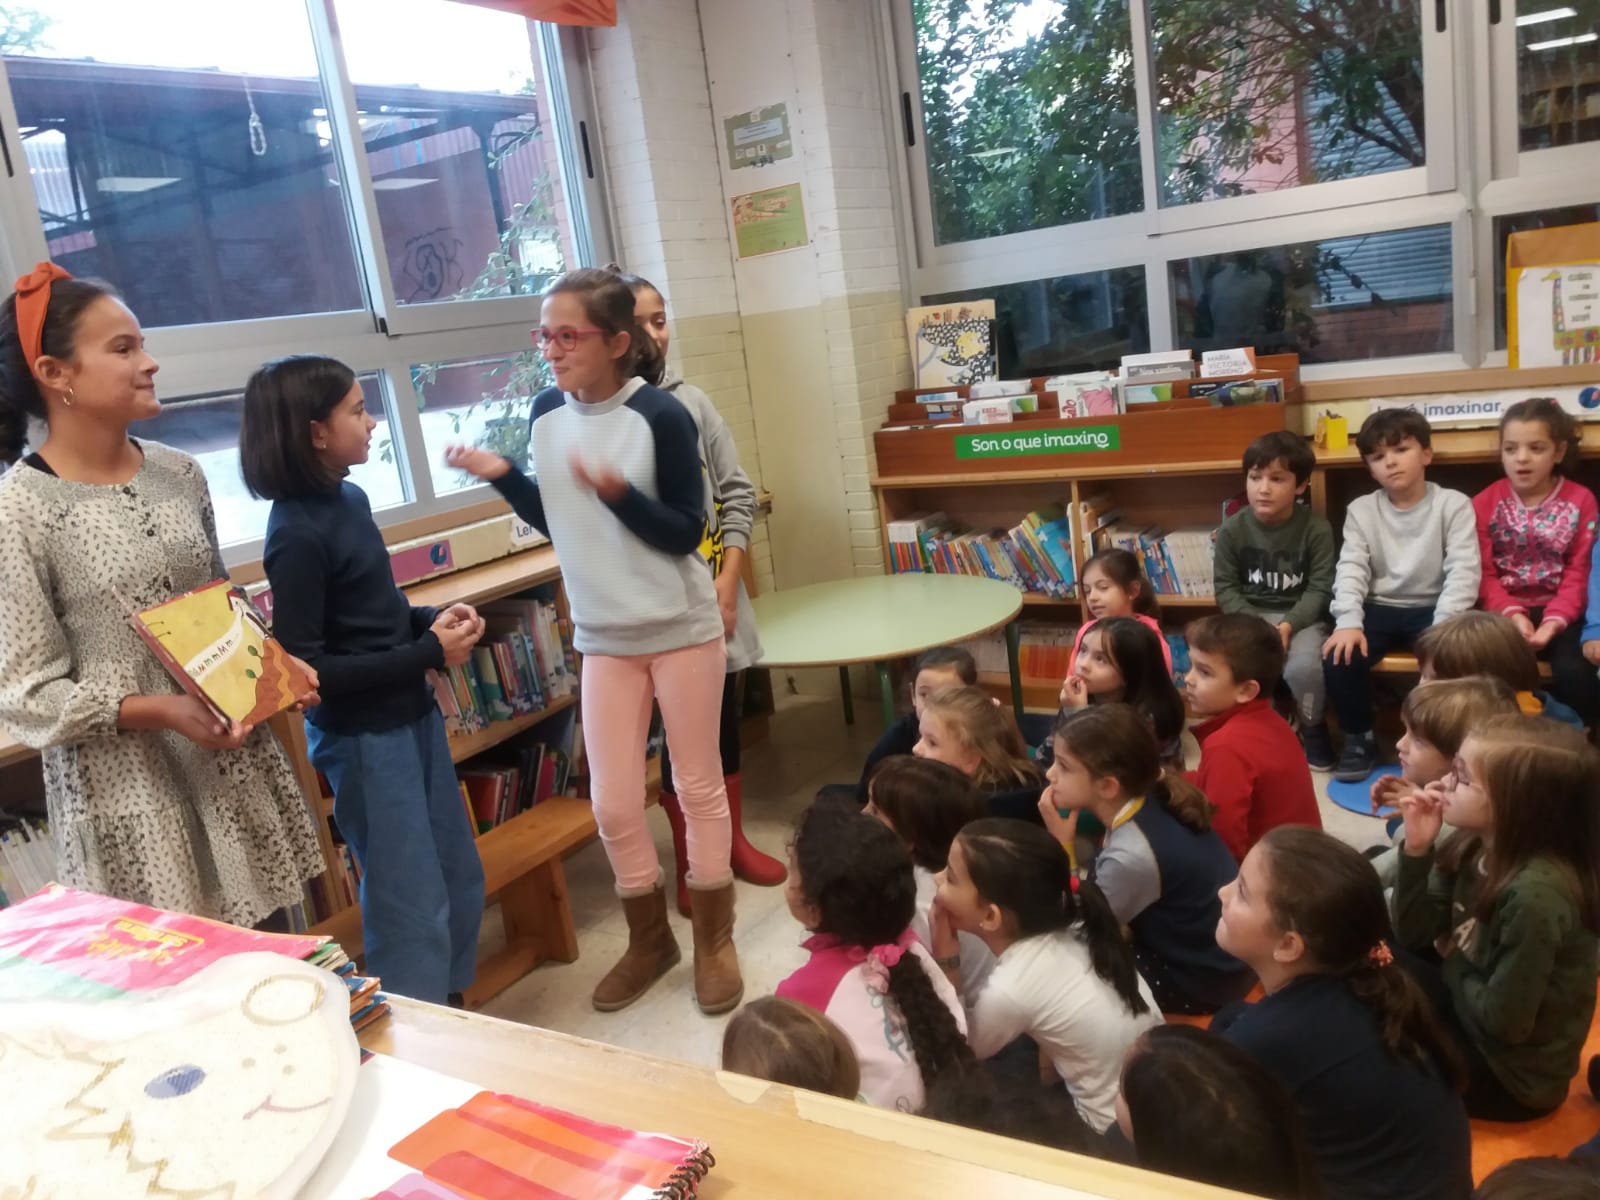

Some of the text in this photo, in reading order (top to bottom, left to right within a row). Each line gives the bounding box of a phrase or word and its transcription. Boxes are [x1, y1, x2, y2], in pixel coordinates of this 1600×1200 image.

[971, 438, 1000, 452] Son
[1001, 438, 1012, 450] o
[1013, 436, 1042, 451] que
